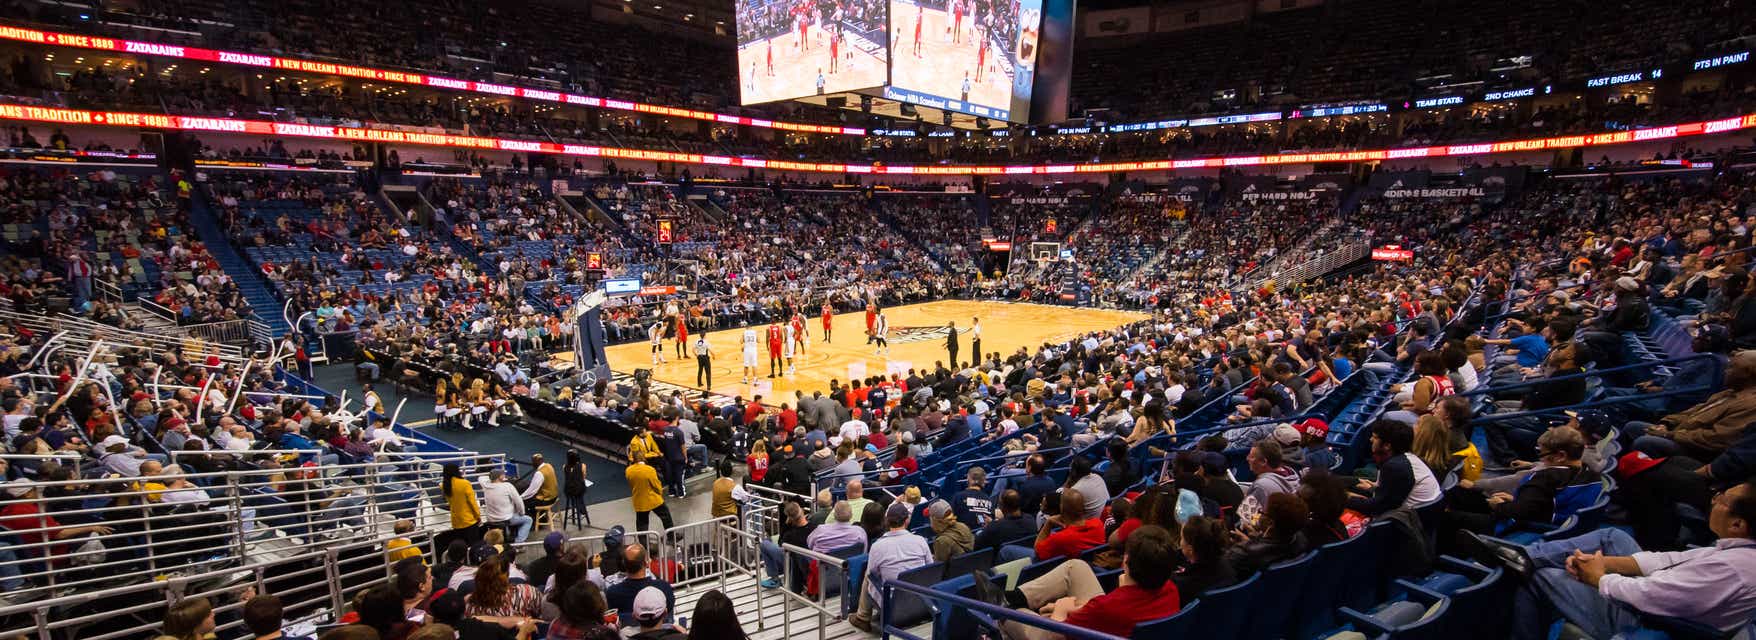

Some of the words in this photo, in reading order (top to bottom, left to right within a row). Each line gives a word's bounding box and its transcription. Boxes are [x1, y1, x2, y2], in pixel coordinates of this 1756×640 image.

[58, 34, 88, 47] SINCE
[91, 38, 114, 49] 1889
[275, 58, 281, 67] A
[282, 59, 300, 70] NEW
[302, 61, 336, 74] ORLEANS
[338, 66, 376, 78] TRADITION
[384, 71, 403, 81] SINCE
[1694, 60, 1711, 70] PTS
[1712, 57, 1722, 67] IN
[1723, 52, 1749, 65] PAINT
[1588, 77, 1609, 87] FAST
[1610, 73, 1642, 84] BREAK
[1651, 69, 1662, 79] 14
[1484, 92, 1501, 101] 2ND
[1502, 88, 1535, 100] CHANCE
[1545, 85, 1551, 94] 3
[1416, 100, 1437, 108] TEAM
[27, 107, 91, 123] TRADITION
[106, 113, 140, 125] SINCE
[144, 115, 168, 127] 1889
[338, 128, 345, 138] A
[346, 128, 364, 140] NEW
[367, 130, 404, 142] ORLEANS
[406, 133, 446, 145] TRADITION
[455, 137, 475, 146] SINCE
[1493, 144, 1498, 152] A
[1499, 142, 1513, 151] NEW
[1514, 139, 1544, 150] ORLEANS
[1546, 137, 1584, 148] TRADITION
[1593, 133, 1612, 144] SINCE
